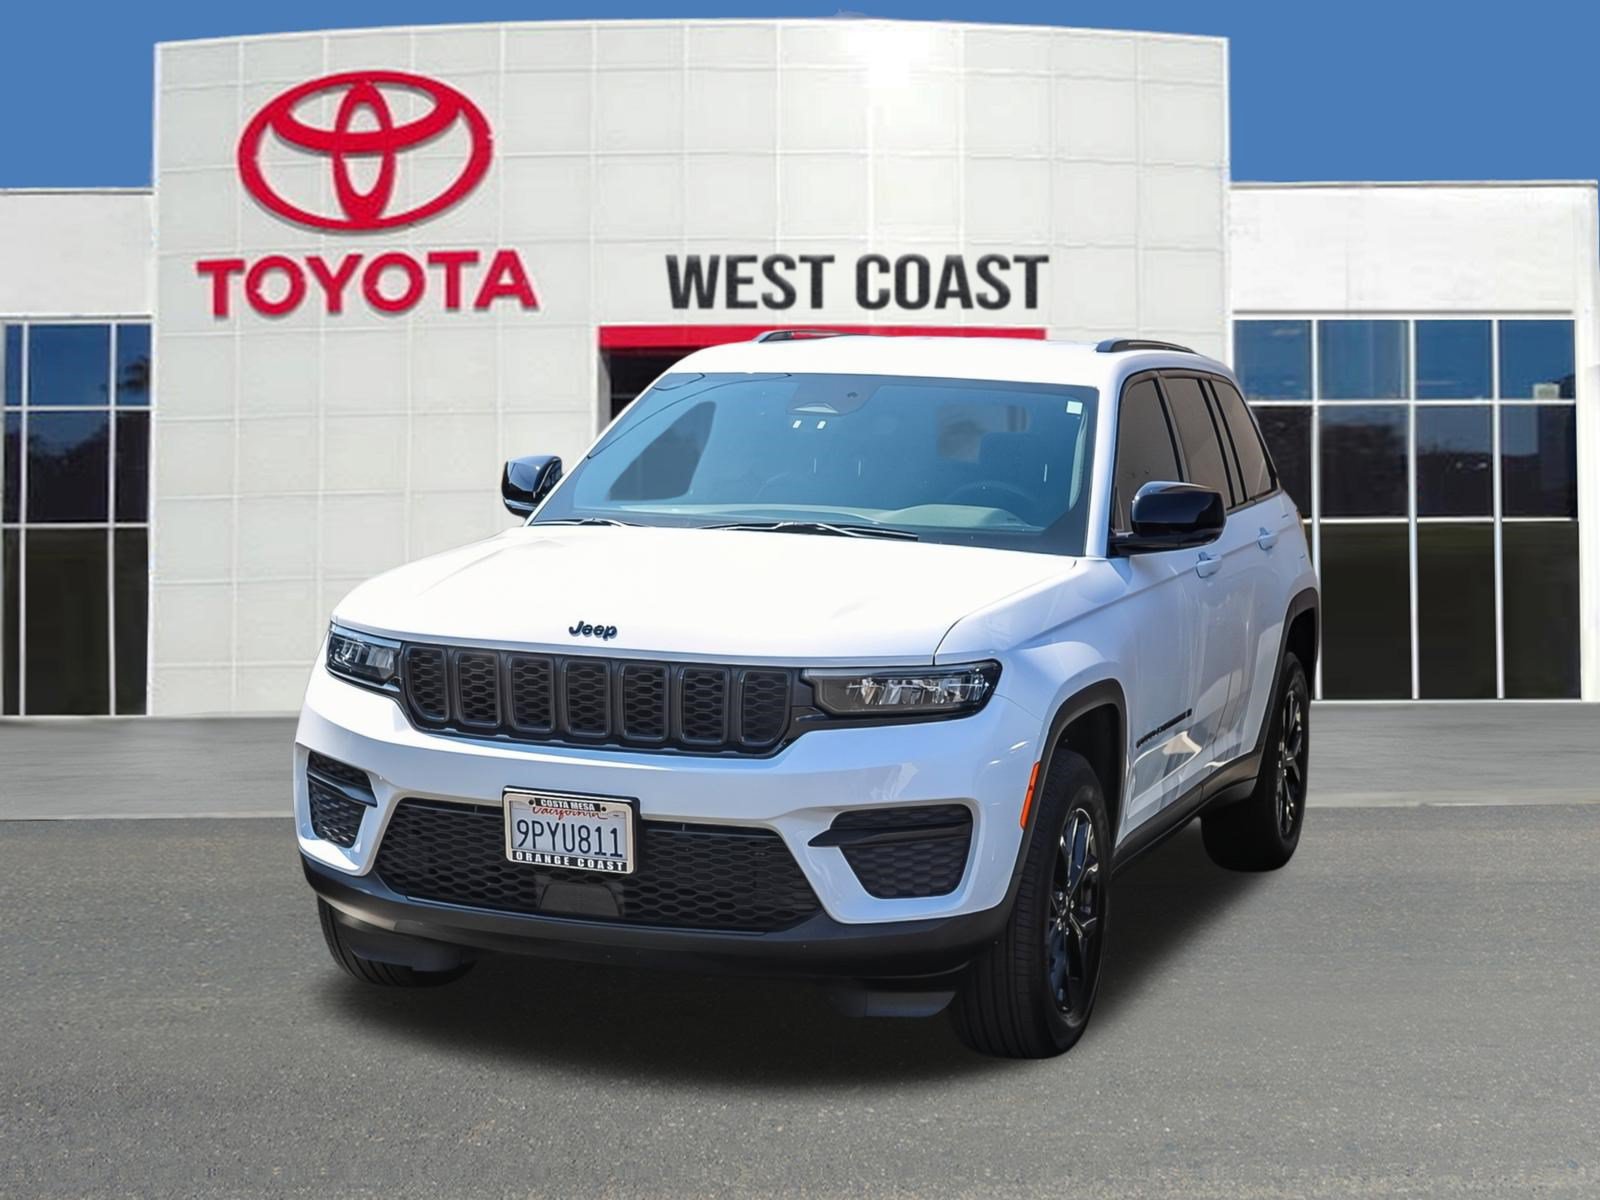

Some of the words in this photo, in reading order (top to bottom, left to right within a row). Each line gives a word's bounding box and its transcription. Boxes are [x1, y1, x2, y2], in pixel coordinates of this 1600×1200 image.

[196, 249, 539, 318] TOYOTA
[665, 253, 835, 310] WEST
[855, 253, 1050, 310] COAST
[568, 620, 618, 641] Jeep
[540, 799, 569, 809] COSTA
[570, 801, 596, 811] MESA
[516, 819, 623, 858] 9PYU811
[516, 851, 570, 866] ORANGE
[577, 858, 623, 871] COAST
